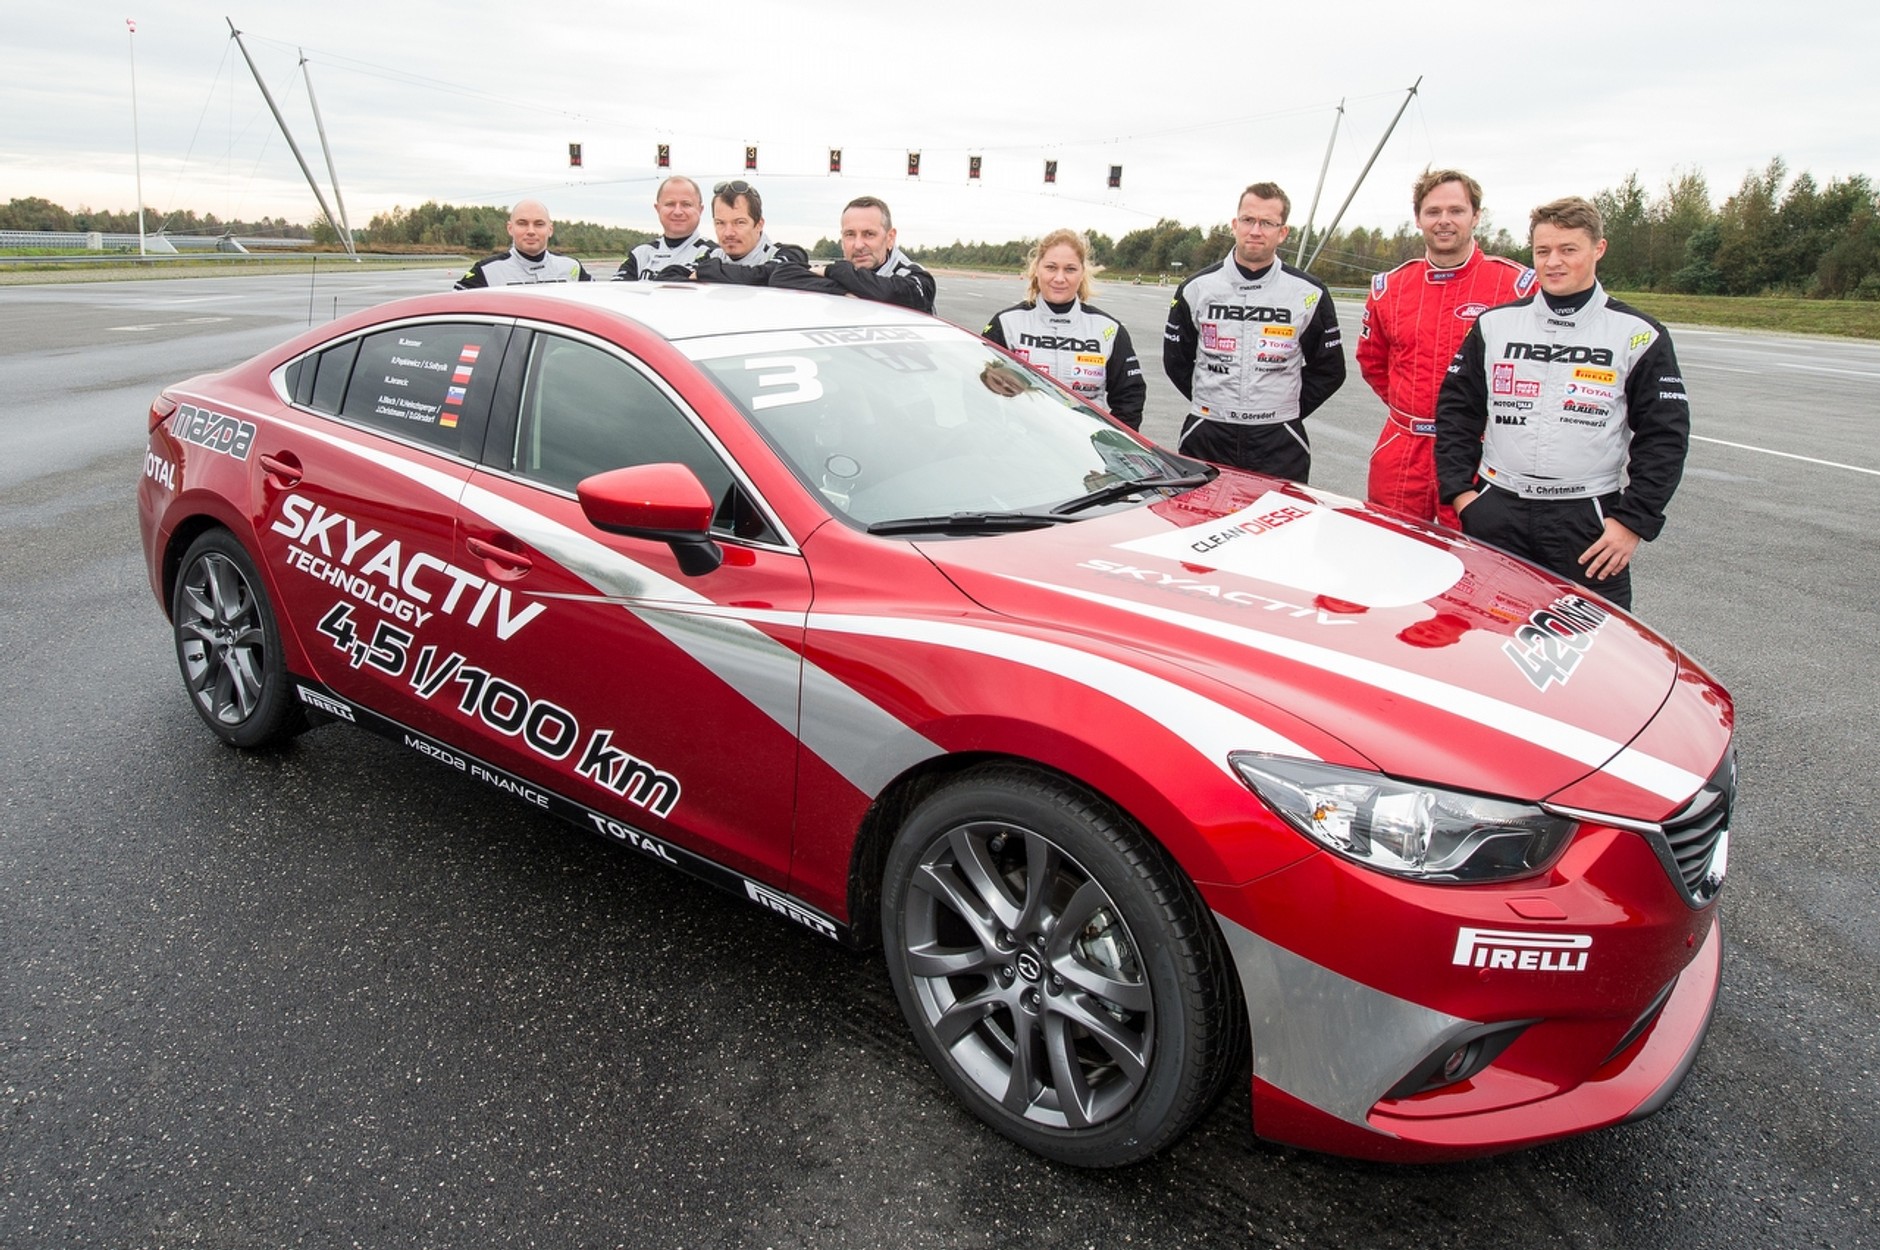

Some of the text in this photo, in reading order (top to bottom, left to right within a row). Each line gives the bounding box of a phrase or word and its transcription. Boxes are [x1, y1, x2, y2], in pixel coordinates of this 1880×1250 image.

[1207, 305, 1292, 324] mazda
[1019, 333, 1101, 354] mazda
[1503, 342, 1614, 367] mazda
[744, 355, 823, 410] 3
[1580, 385, 1614, 399] TOTAL
[170, 402, 257, 461] mazda
[1241, 411, 1276, 420] Görsdorf
[1495, 414, 1528, 426] DMAX
[1525, 484, 1586, 496] J. Christmann
[271, 494, 547, 641] SKYACTIV
[286, 544, 433, 629] TECHNOLOGY
[1075, 559, 1360, 626] SKYACTIV
[296, 684, 356, 722] PIRELLI
[316, 600, 414, 677] 4,5
[574, 729, 682, 819] km
[470, 764, 550, 809] FINANCE
[587, 813, 678, 864] TOTAL
[743, 879, 840, 942] PIRELLI
[1452, 926, 1593, 971] PIRELLI
